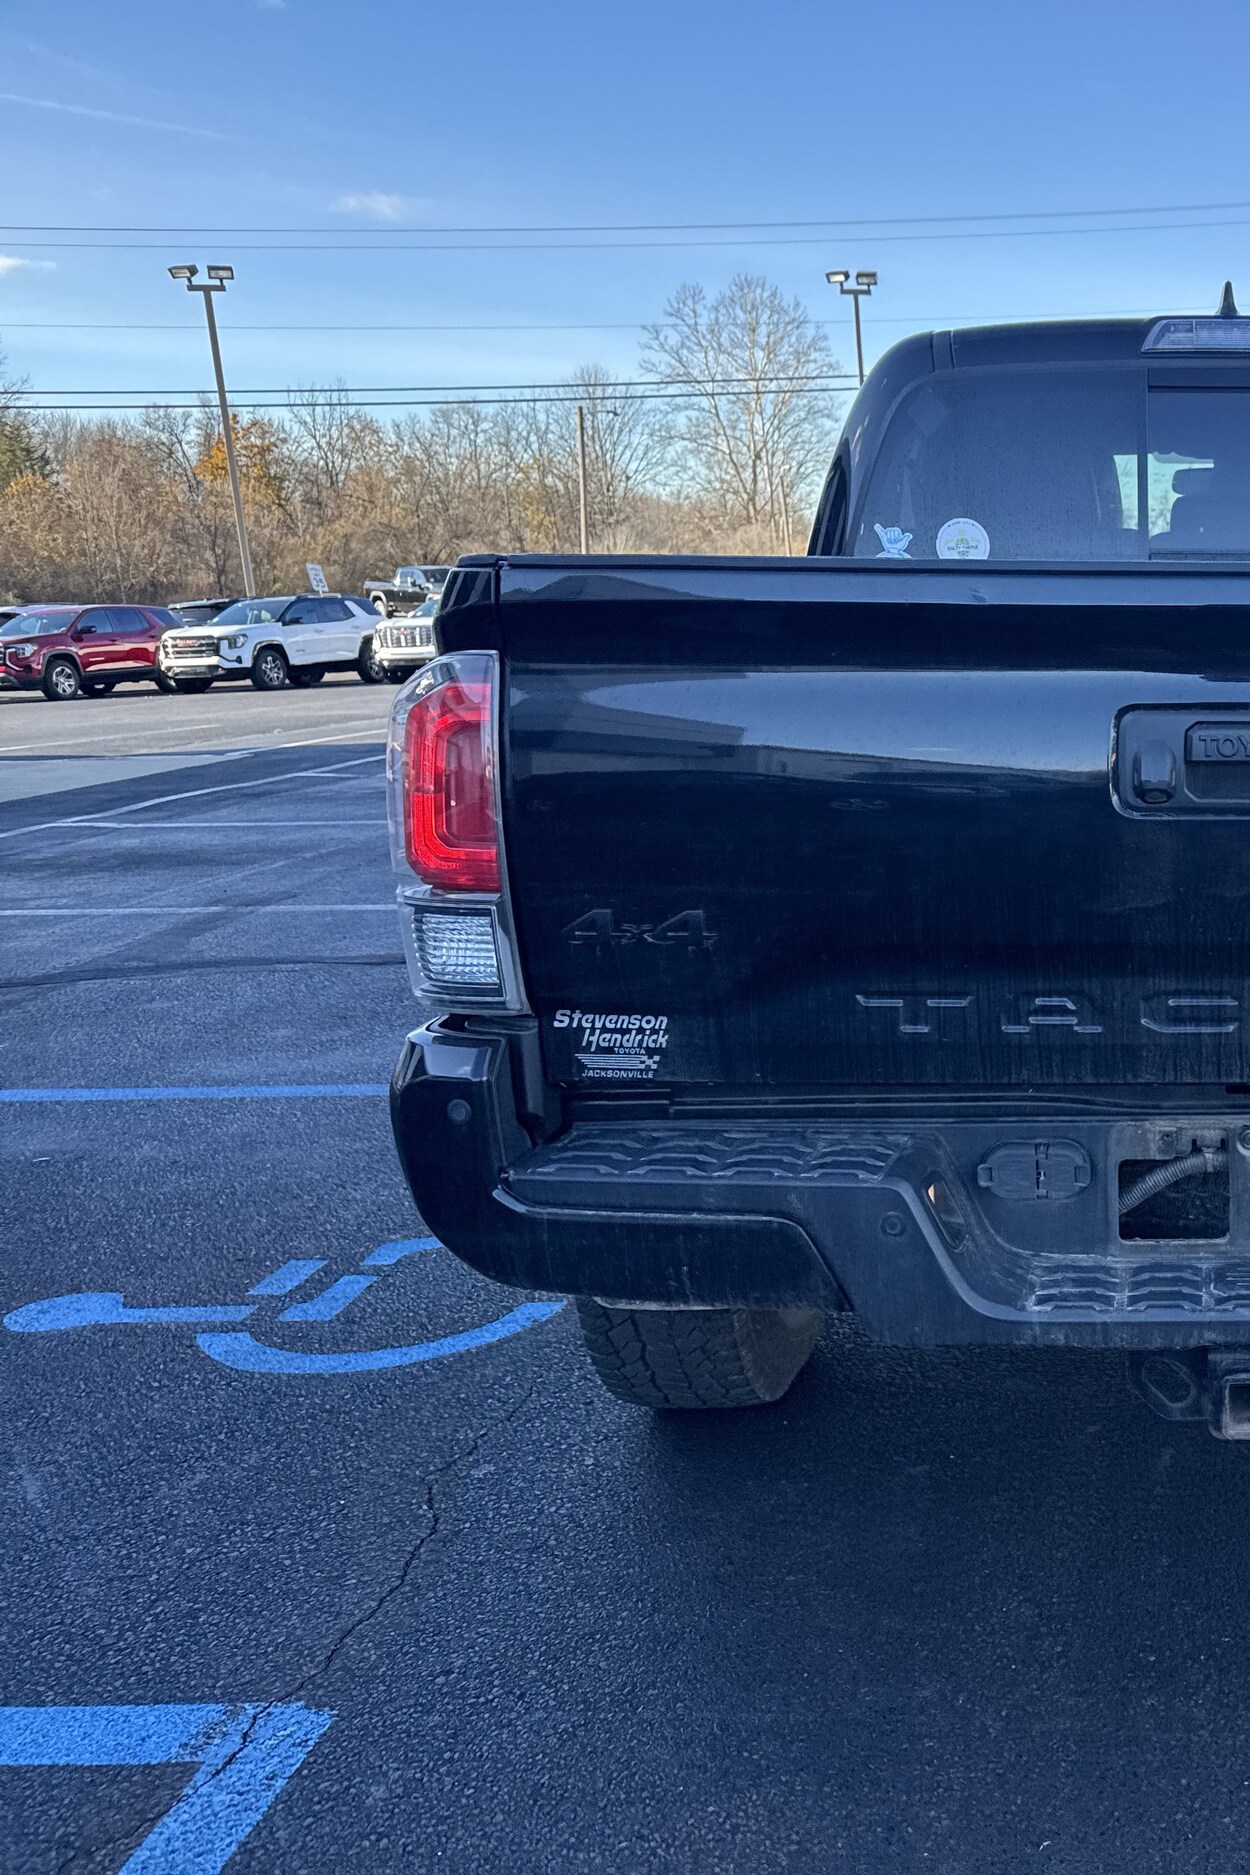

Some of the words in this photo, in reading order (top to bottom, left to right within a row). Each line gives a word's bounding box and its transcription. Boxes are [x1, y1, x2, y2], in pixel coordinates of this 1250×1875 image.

[313, 577, 326, 589] 35
[554, 1010, 668, 1029] Stevenson
[582, 1029, 668, 1051] Hendrick
[582, 1070, 654, 1078] JACKSONVILLE
